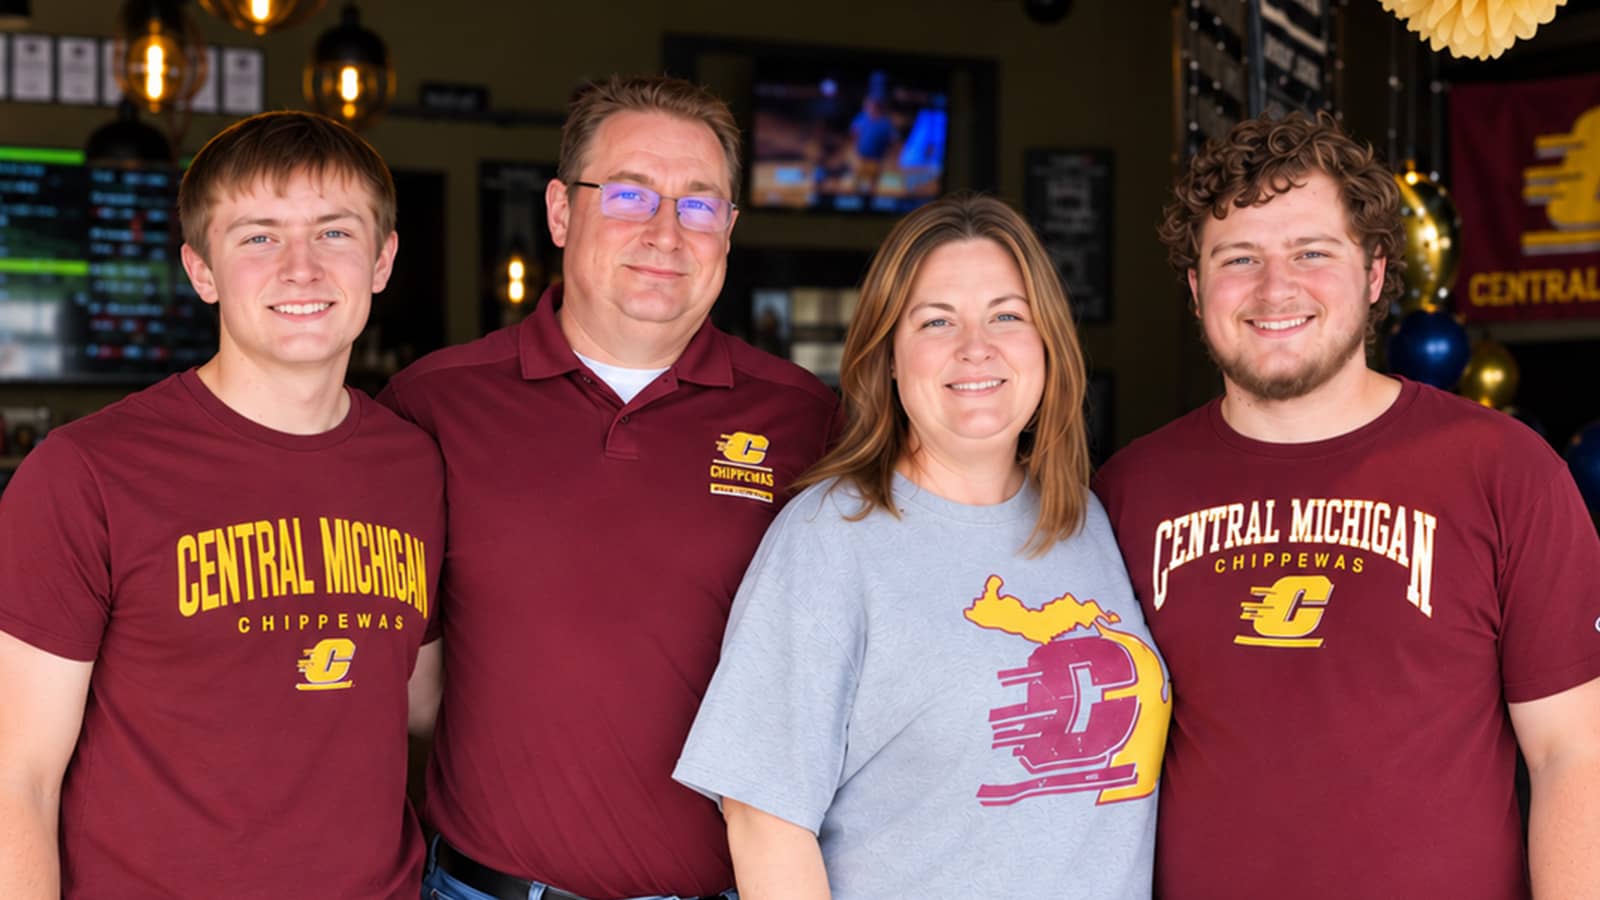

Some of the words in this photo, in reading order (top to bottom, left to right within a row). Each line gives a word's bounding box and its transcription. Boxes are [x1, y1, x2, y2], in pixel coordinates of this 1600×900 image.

[1469, 267, 1600, 306] CENTRAL
[177, 517, 315, 617] CENTRAL
[319, 516, 428, 619] MICHIGAN
[1153, 500, 1280, 611] CENTRAL
[1288, 499, 1437, 619] MICHIGAN
[1214, 552, 1365, 573] CHIPPEWAS
[238, 613, 404, 633] CHIPPEWAS
